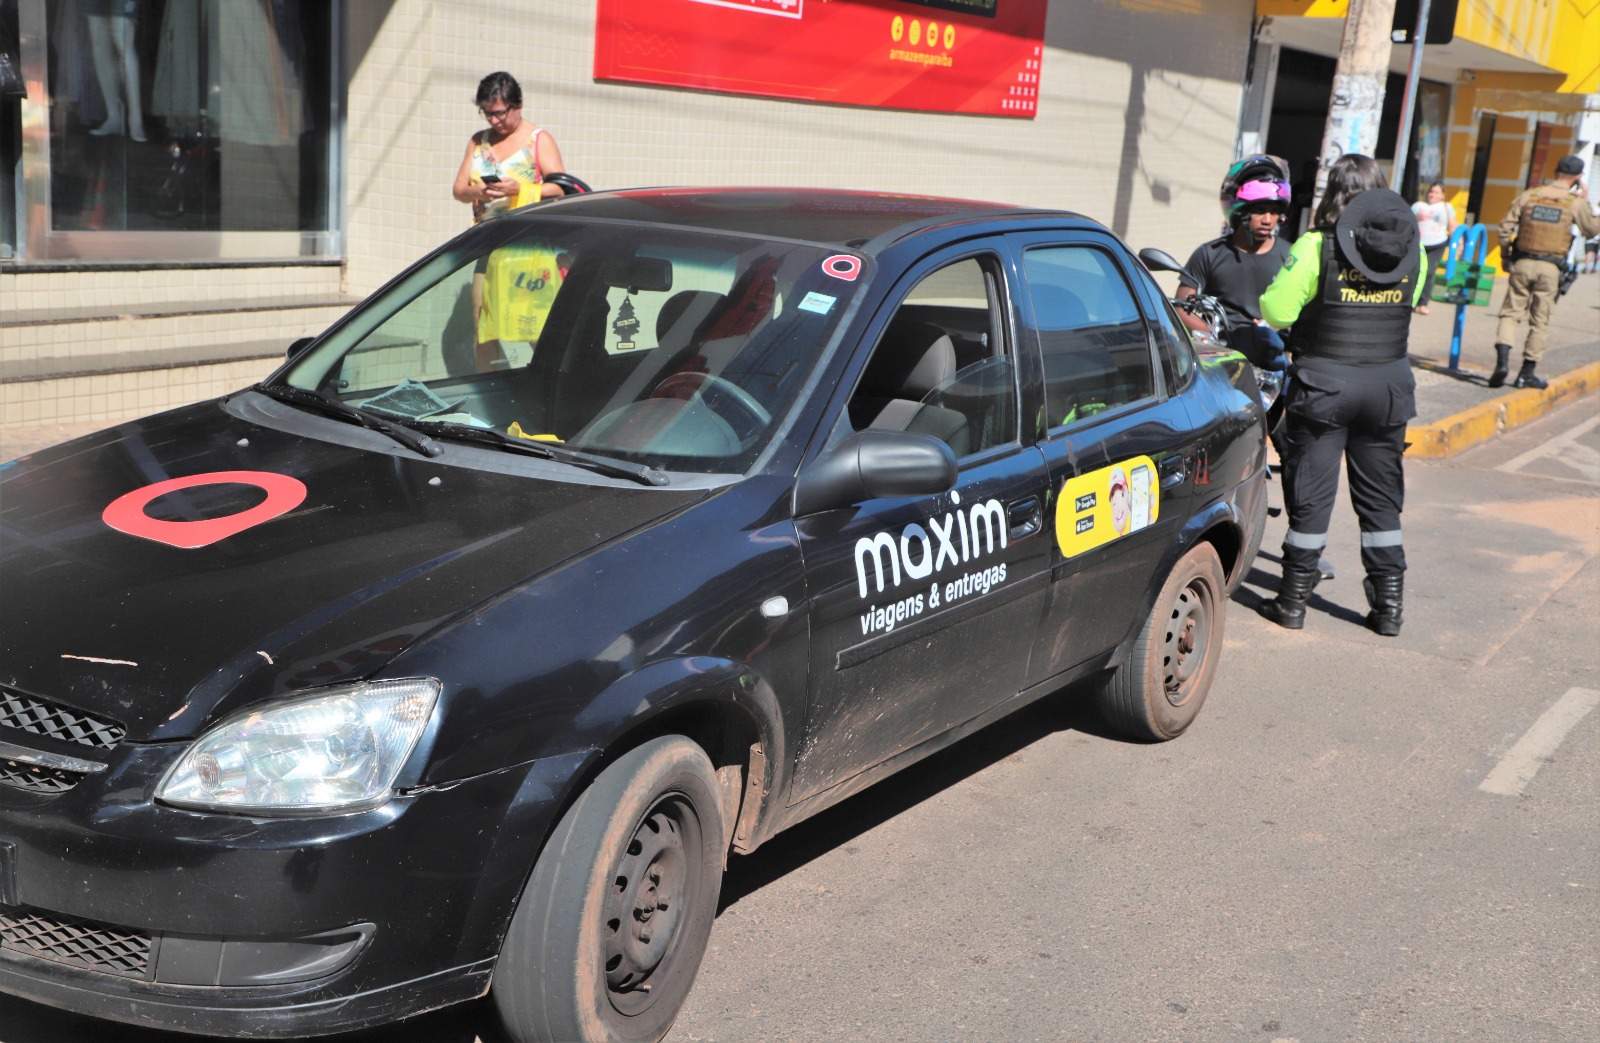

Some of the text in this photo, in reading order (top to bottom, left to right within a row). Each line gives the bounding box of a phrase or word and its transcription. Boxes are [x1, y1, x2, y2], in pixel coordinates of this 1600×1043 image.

[1340, 285, 1403, 304] TRÂNSITO
[855, 490, 1008, 599] maxim
[861, 562, 1007, 635] viagens & entregas
